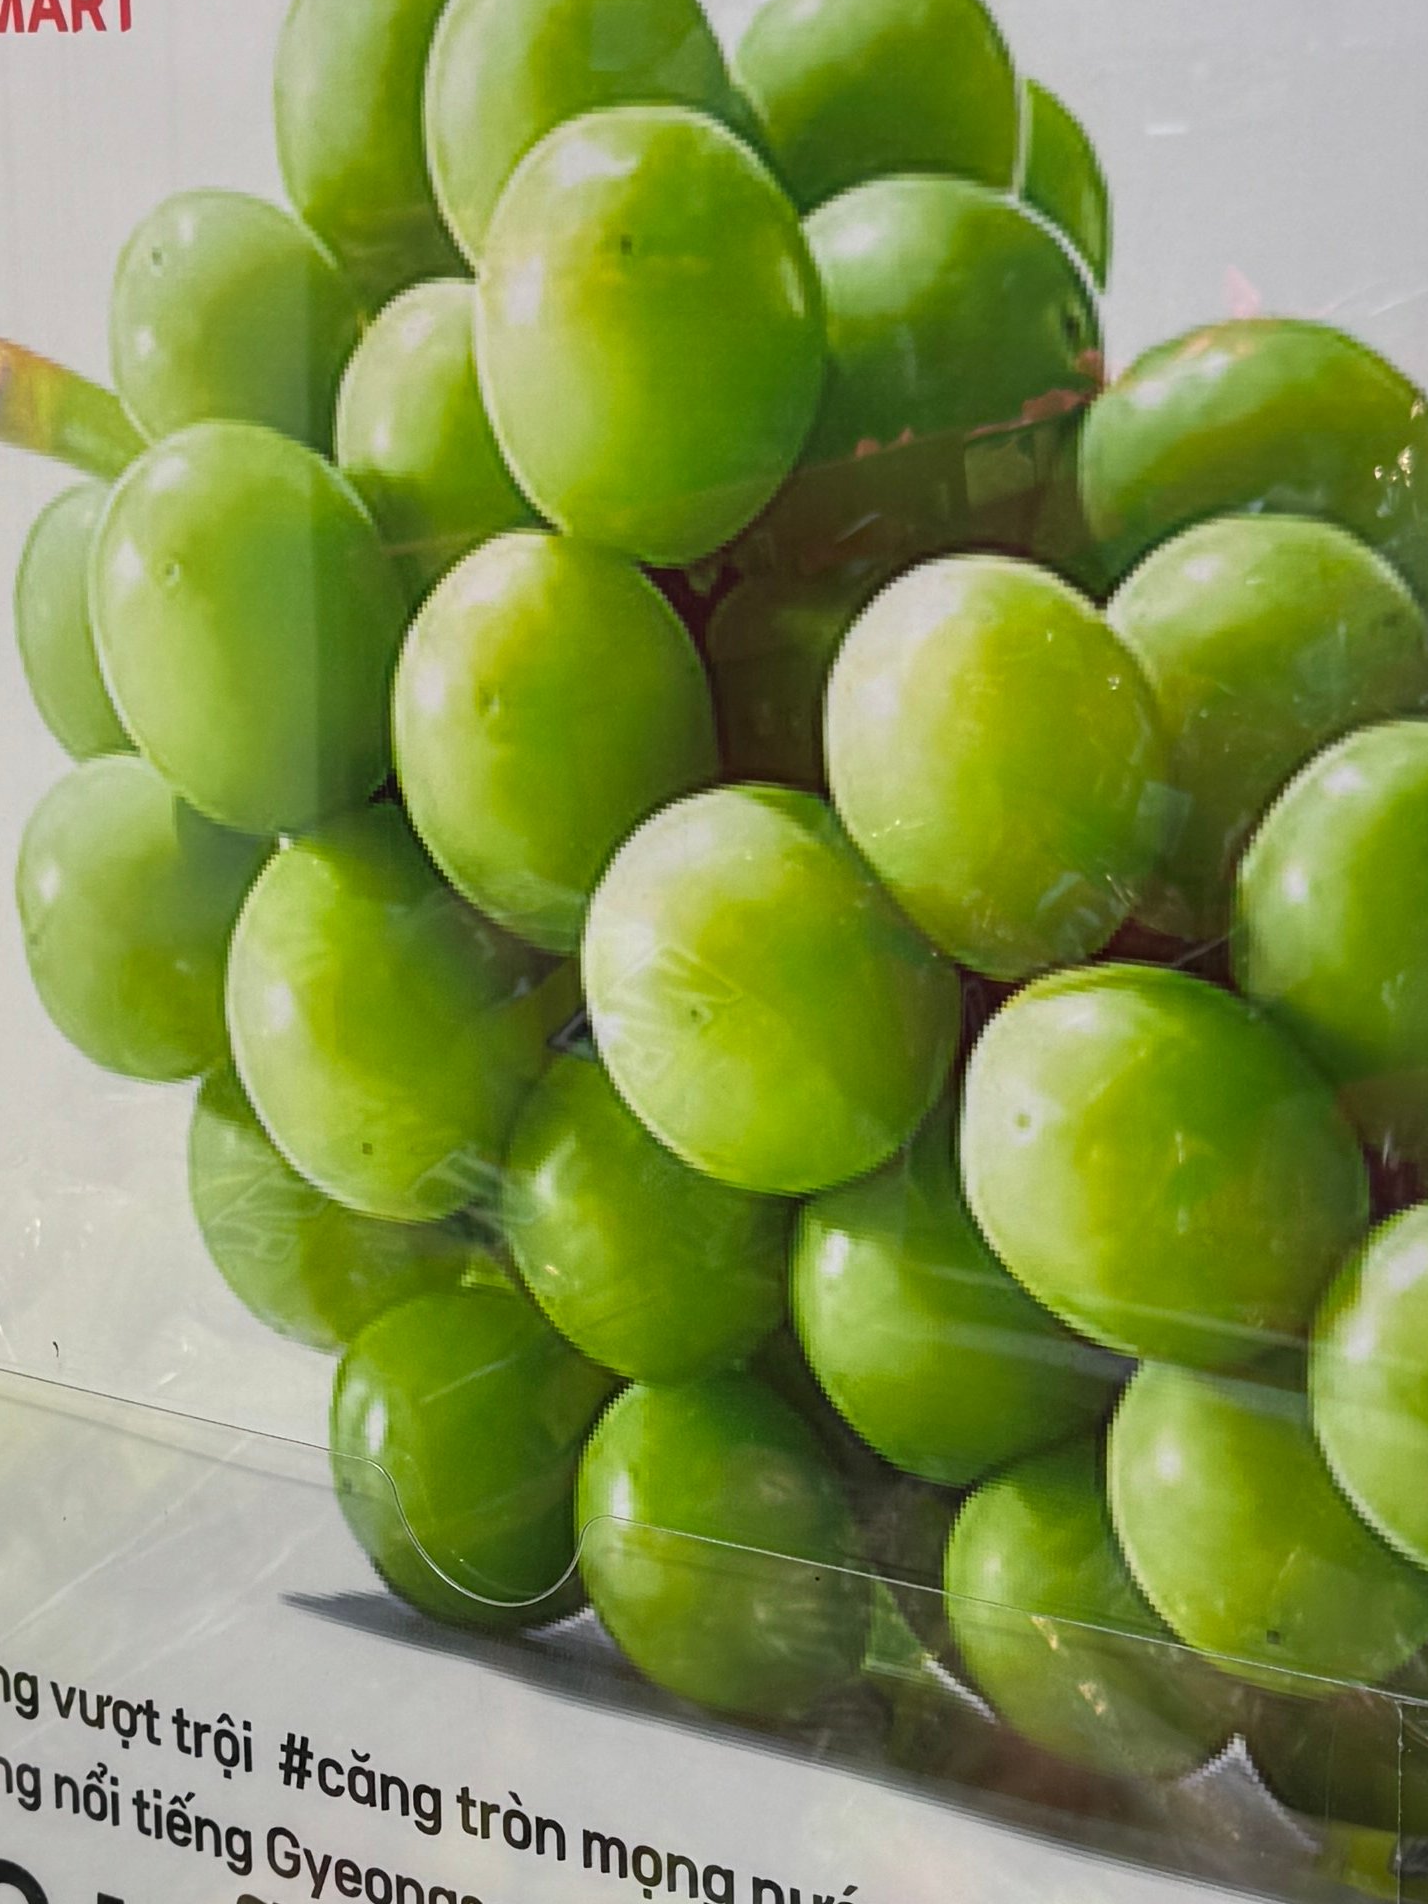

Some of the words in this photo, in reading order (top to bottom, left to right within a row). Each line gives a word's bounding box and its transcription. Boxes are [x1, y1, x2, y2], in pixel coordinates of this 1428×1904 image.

[50, 1680, 162, 1749] vượt
[172, 1706, 254, 1780] trội
[279, 1732, 443, 1835] #căng
[456, 1787, 567, 1862] tròn
[54, 1762, 121, 1826] nổi
[132, 1788, 254, 1877] tiếng
